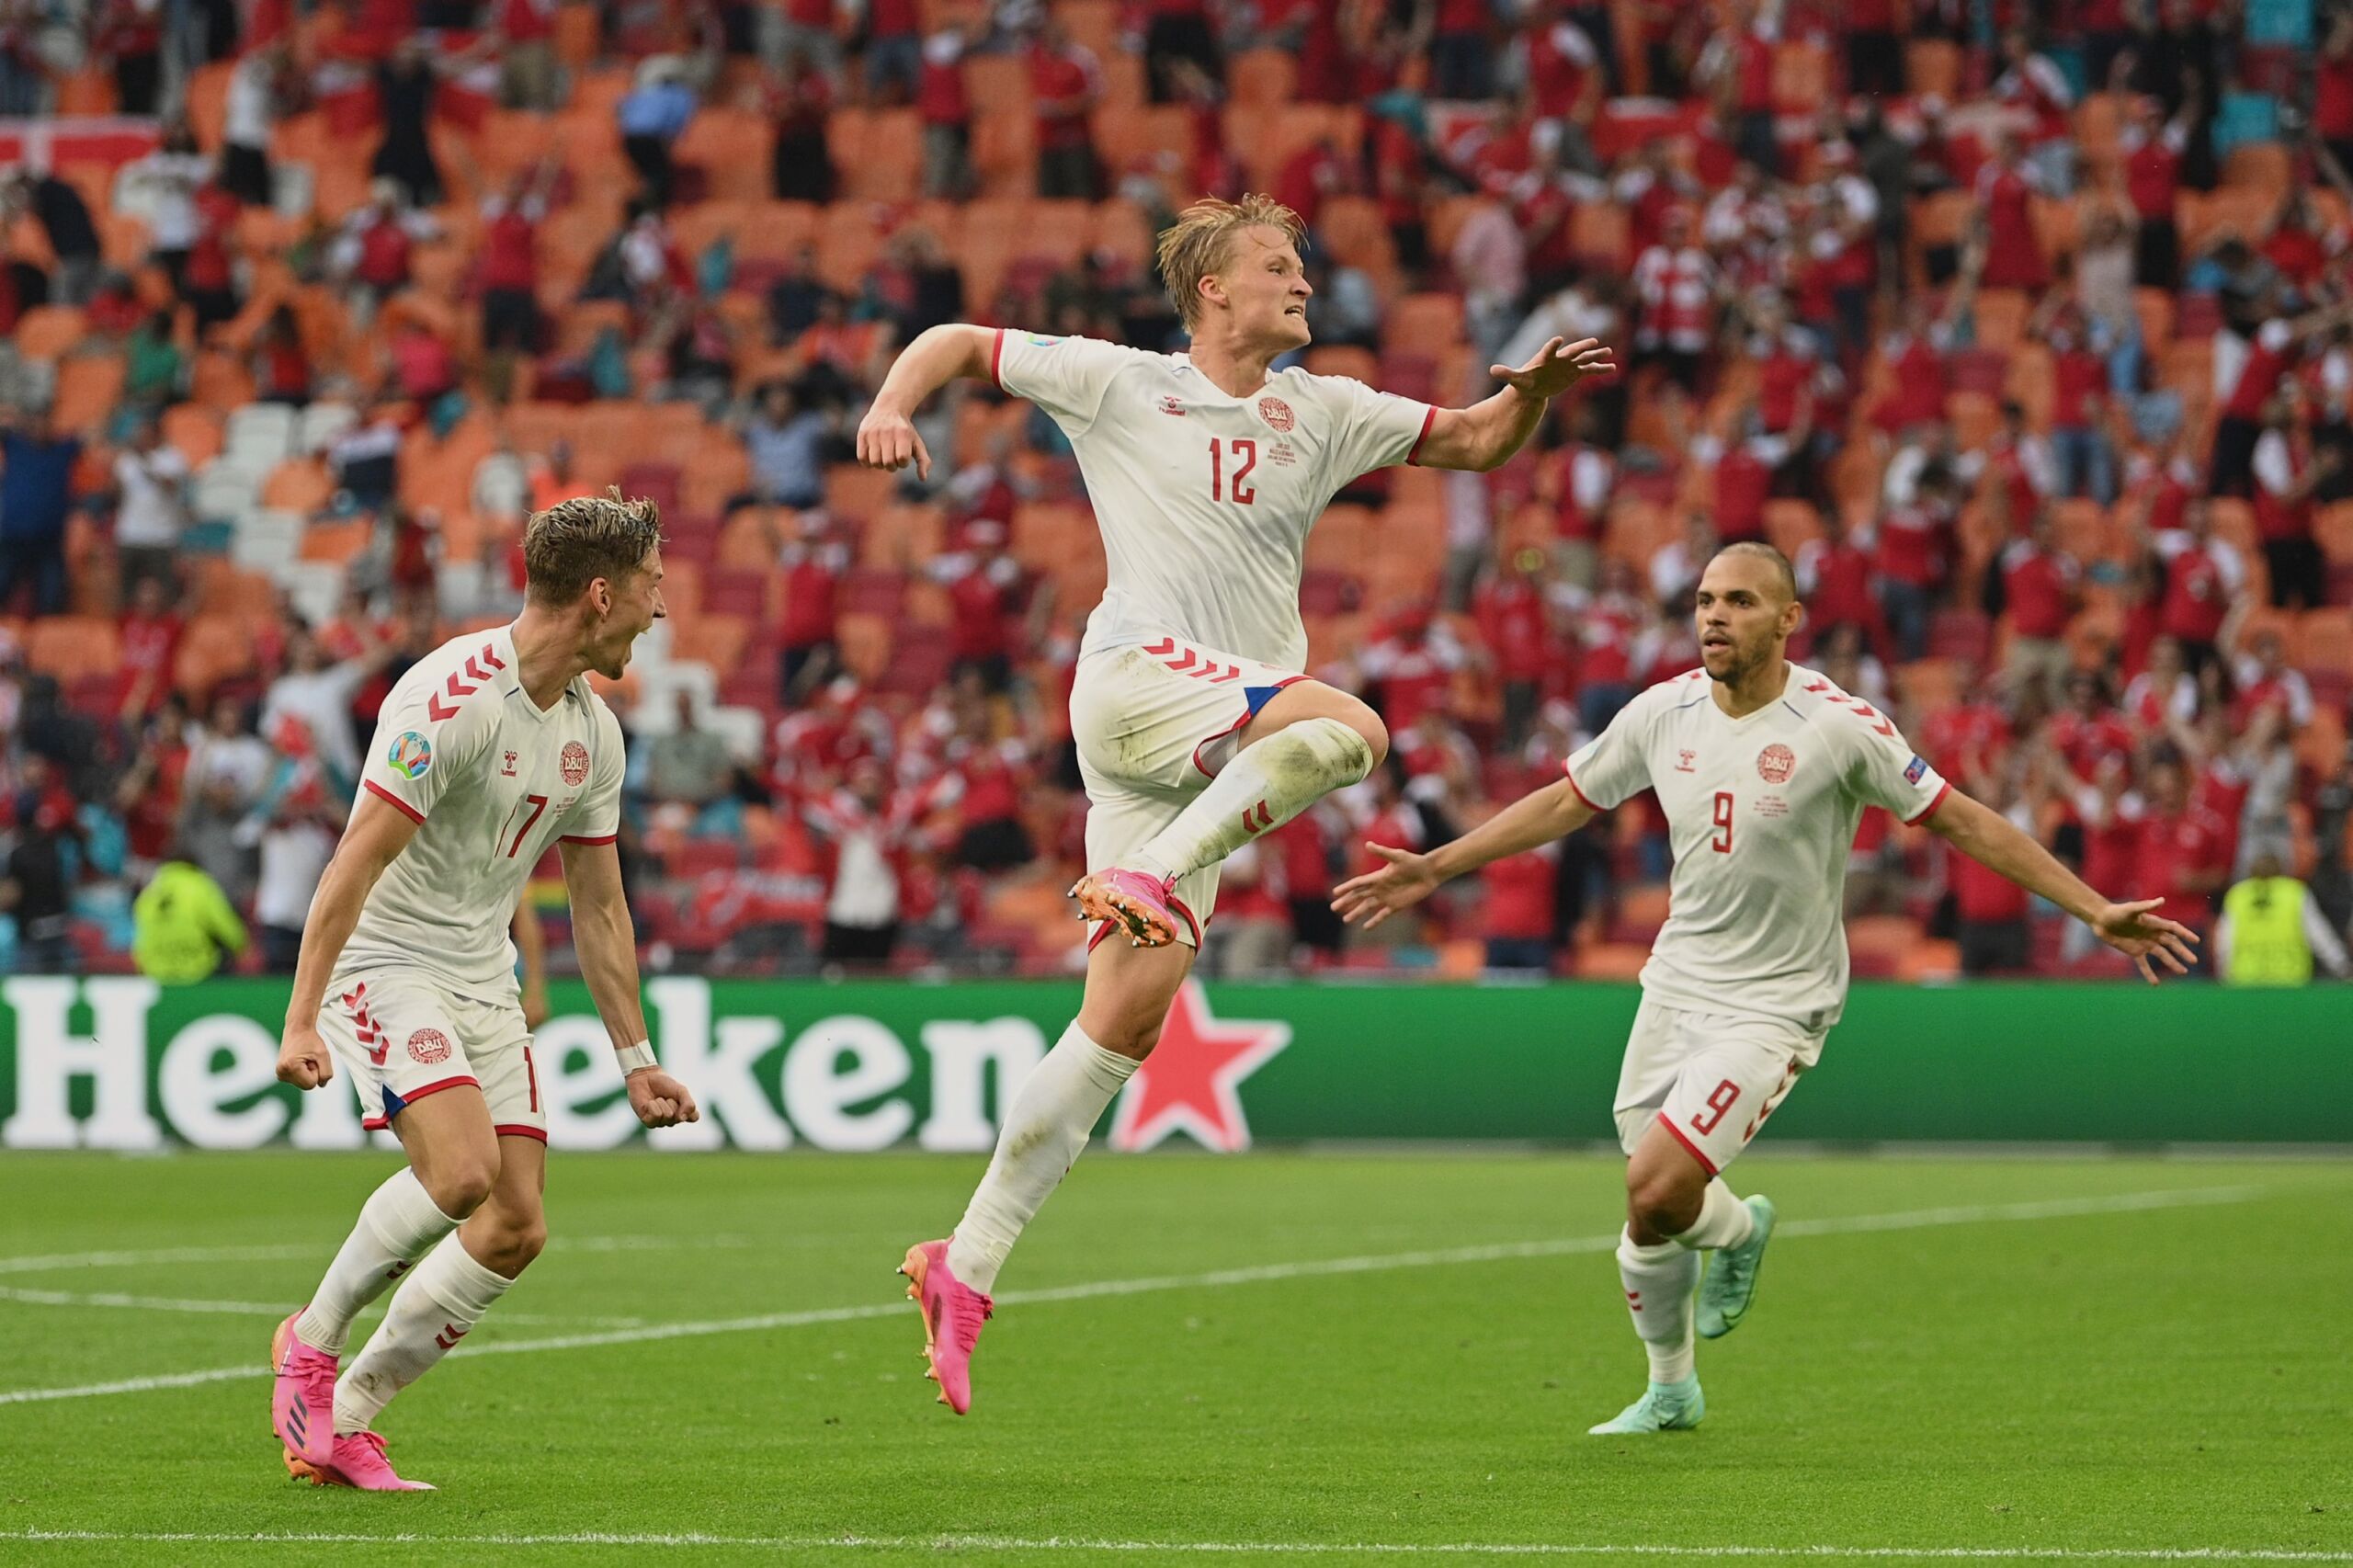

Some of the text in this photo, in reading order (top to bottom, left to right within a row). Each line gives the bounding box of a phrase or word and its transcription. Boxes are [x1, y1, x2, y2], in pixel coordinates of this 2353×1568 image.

[1265, 407, 1288, 420] DBU
[1209, 437, 1256, 505] 12
[564, 756, 583, 770] DBU
[1765, 756, 1789, 771] DBU
[1712, 791, 1733, 854] 9
[3, 977, 1046, 1151] Heeken
[415, 1039, 443, 1054] DBU
[1690, 1078, 1741, 1135] 9
